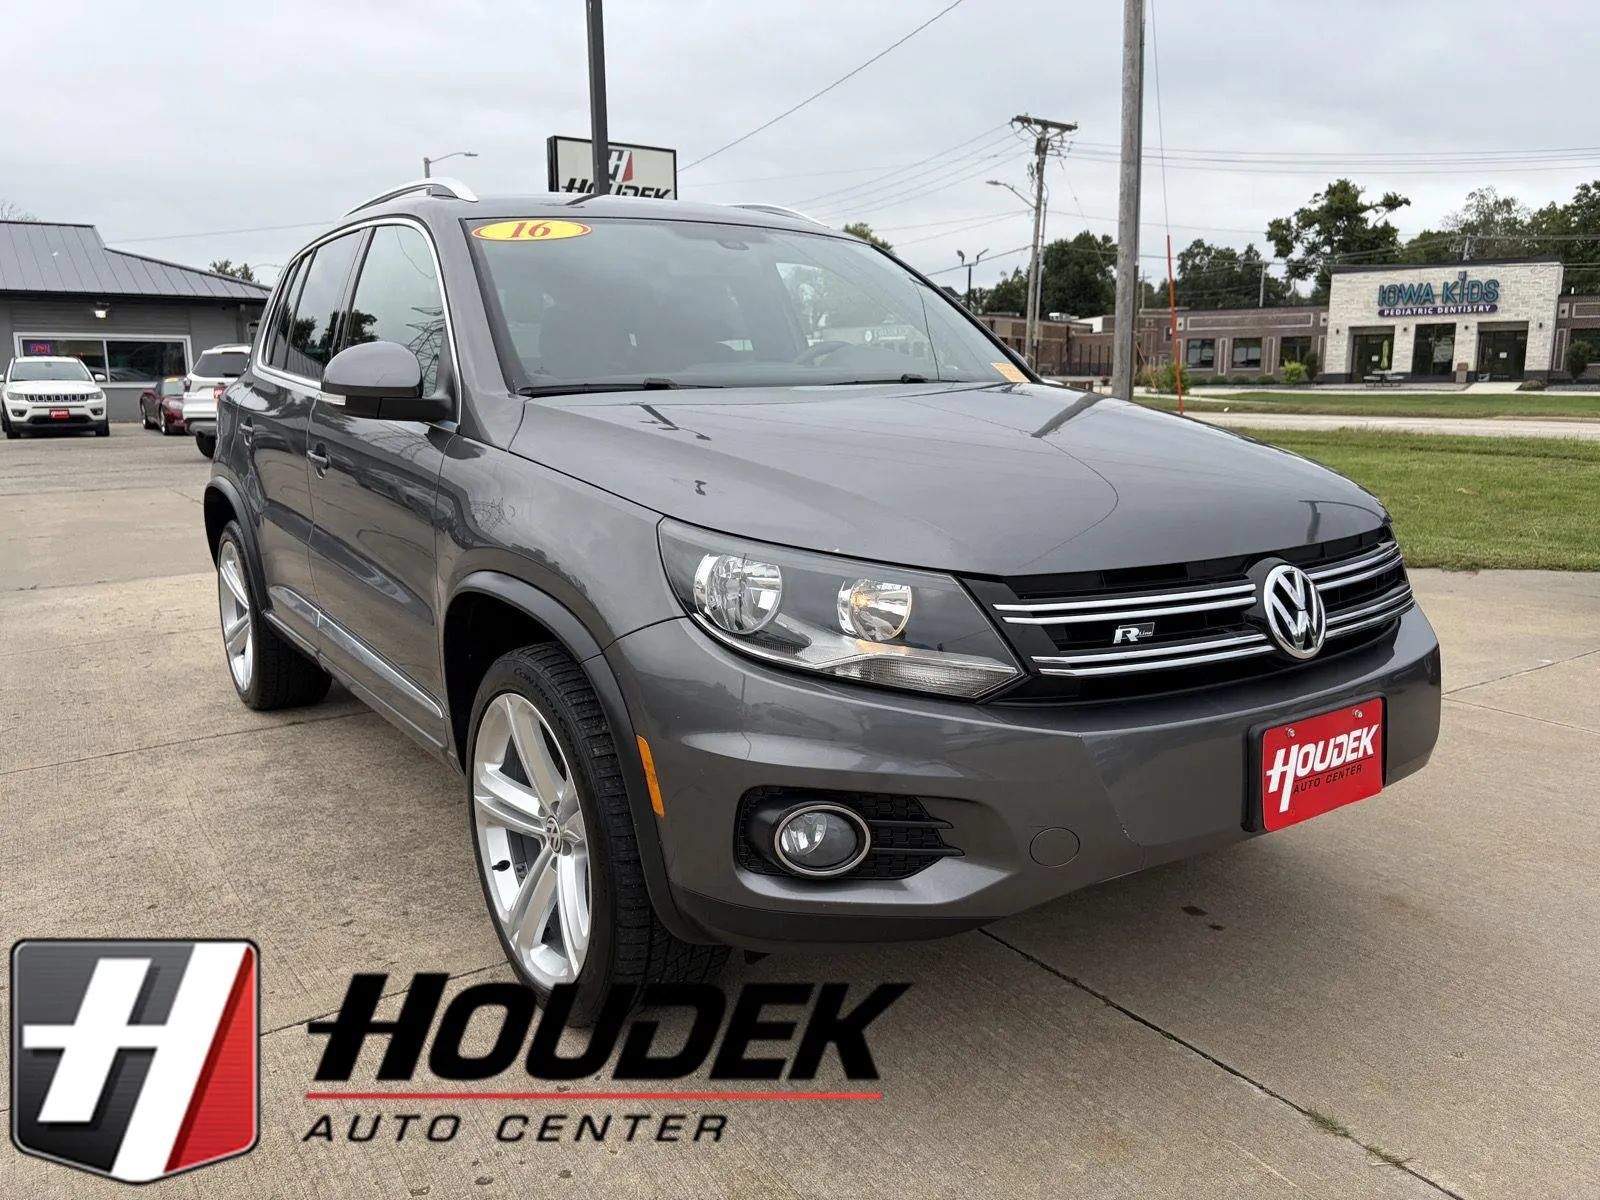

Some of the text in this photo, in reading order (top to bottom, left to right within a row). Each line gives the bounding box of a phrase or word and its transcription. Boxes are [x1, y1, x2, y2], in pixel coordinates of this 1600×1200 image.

[561, 178, 672, 199] HDEK
[508, 221, 551, 239] 16
[1377, 270, 1500, 307] IOWA KIDS
[1384, 304, 1491, 316] PEDIATRIC DENTISTRY
[1113, 627, 1140, 644] R
[1266, 723, 1380, 813] HOUDEK
[1293, 764, 1363, 795] AUTO CENTER
